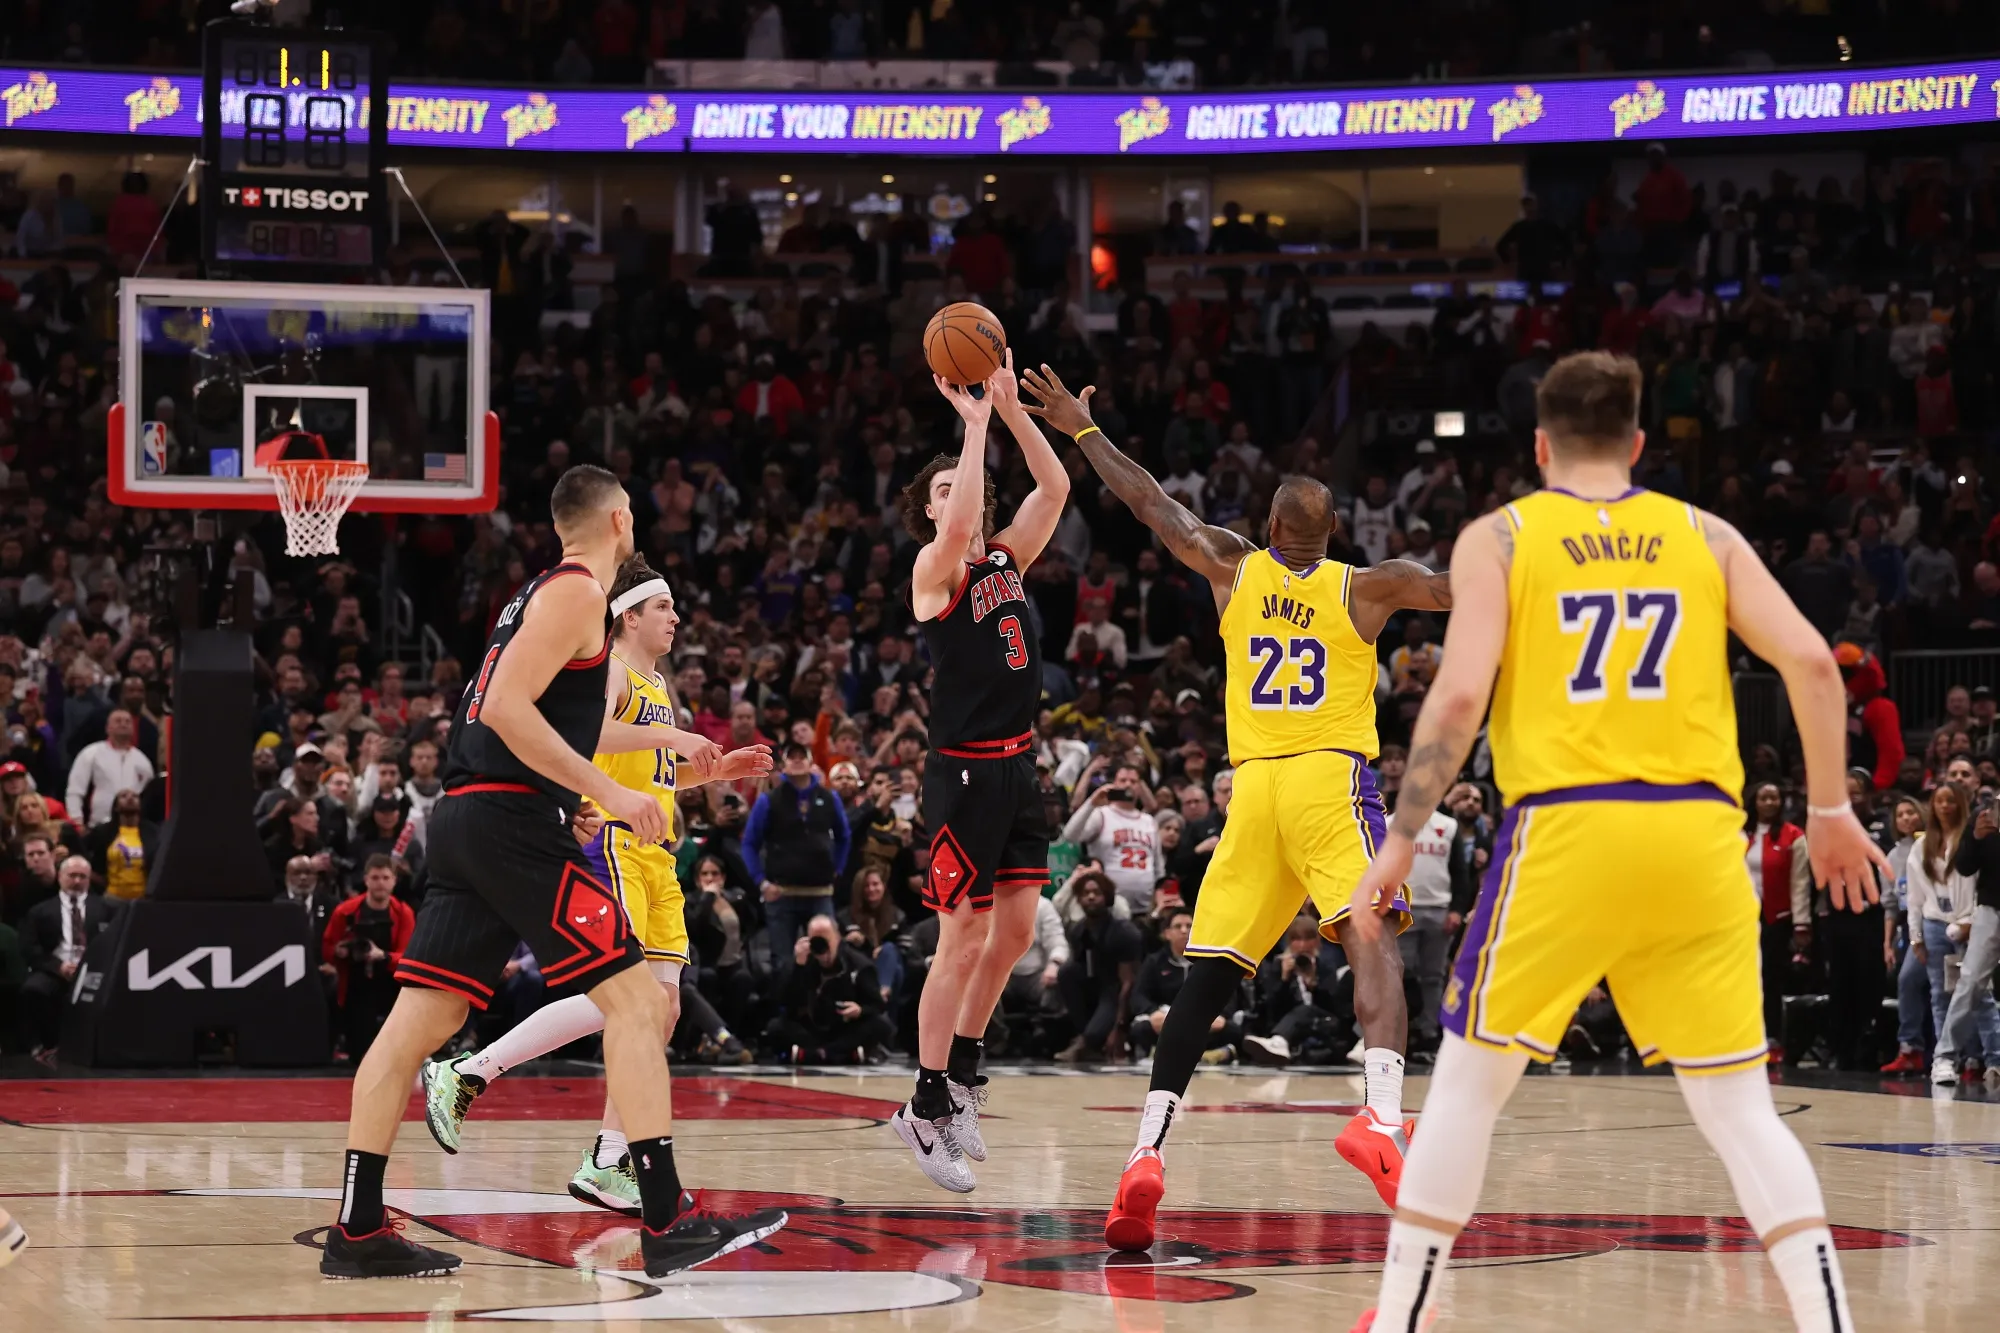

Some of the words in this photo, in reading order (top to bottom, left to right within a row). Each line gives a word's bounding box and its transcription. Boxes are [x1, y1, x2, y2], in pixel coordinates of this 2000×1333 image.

[692, 103, 778, 138] IGNITE
[781, 104, 849, 139] YOUR
[852, 104, 984, 140] INTENSITY
[1185, 103, 1271, 140] IGNITE
[1275, 101, 1341, 138] YOUR
[1344, 97, 1476, 135] INTENSITY
[1682, 85, 1769, 123] IGNITE
[1774, 82, 1843, 120] YOUR
[1847, 73, 1979, 116] INTENSITY
[263, 188, 369, 212] TISSOT
[1261, 593, 1316, 630] JAMES
[998, 614, 1029, 671] 3
[1557, 586, 1683, 704] 77
[1248, 634, 1328, 712] 23
[127, 944, 306, 991] KIA
